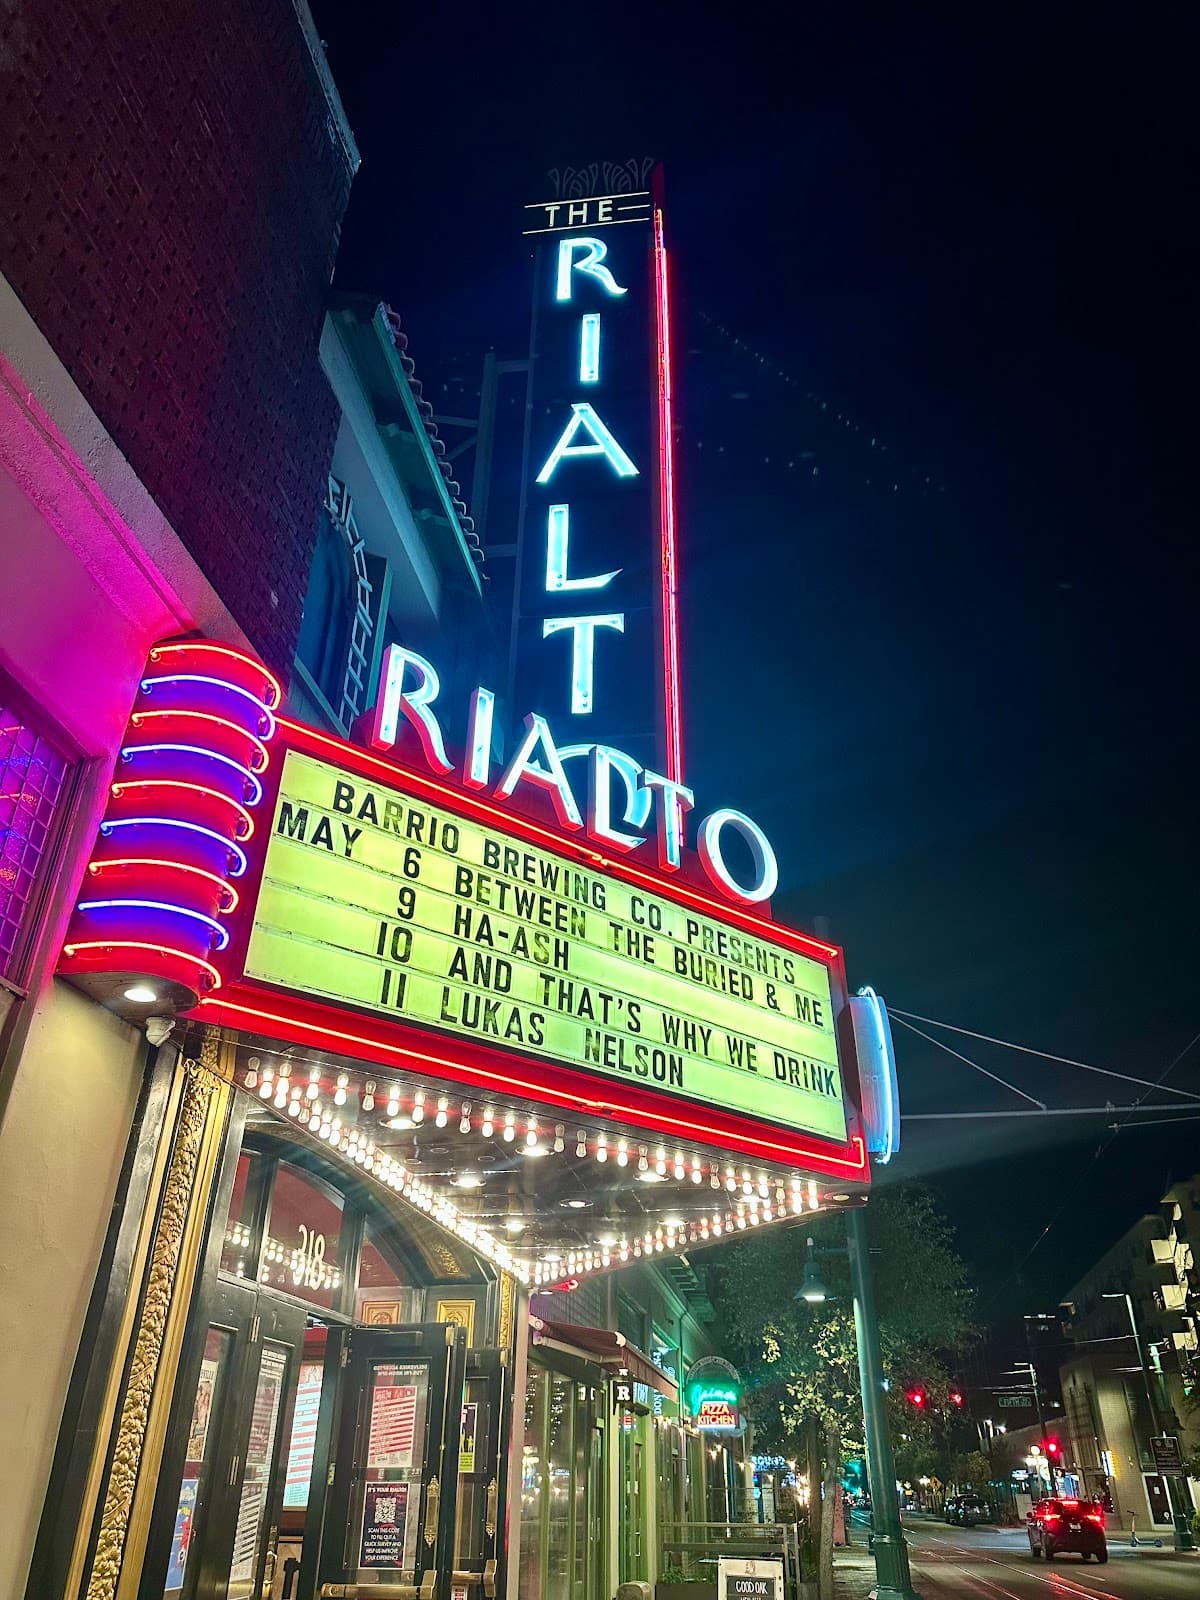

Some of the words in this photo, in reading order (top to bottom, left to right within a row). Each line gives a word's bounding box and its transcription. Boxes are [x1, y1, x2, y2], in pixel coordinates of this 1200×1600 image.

[545, 199, 613, 227] THE
[371, 642, 778, 906] RIALTO
[276, 802, 362, 858] MAY
[403, 847, 421, 879] 6
[455, 865, 586, 940] BETWEEN
[609, 921, 655, 964] THE
[674, 946, 753, 1001] BURIED
[766, 983, 781, 1011] &
[794, 993, 824, 1027] ME
[332, 780, 460, 855] BARRIO
[483, 838, 607, 911] BREWING
[631, 896, 672, 937] CO.
[686, 919, 795, 985] PRESENTS
[397, 886, 416, 920] 9
[454, 904, 569, 971] HA-ASH
[376, 921, 413, 964] 10
[448, 946, 512, 994] AND
[540, 972, 641, 1033] THAT'S
[662, 1013, 713, 1053] WHY
[726, 1035, 758, 1072] WE
[774, 1052, 838, 1098] DRINK
[380, 969, 406, 1008] 11
[440, 986, 545, 1046] LUKAS
[584, 1028, 684, 1088] NELSON
[698, 1415, 735, 1425] KITCHEN
[702, 1403, 729, 1415] PIZZA
